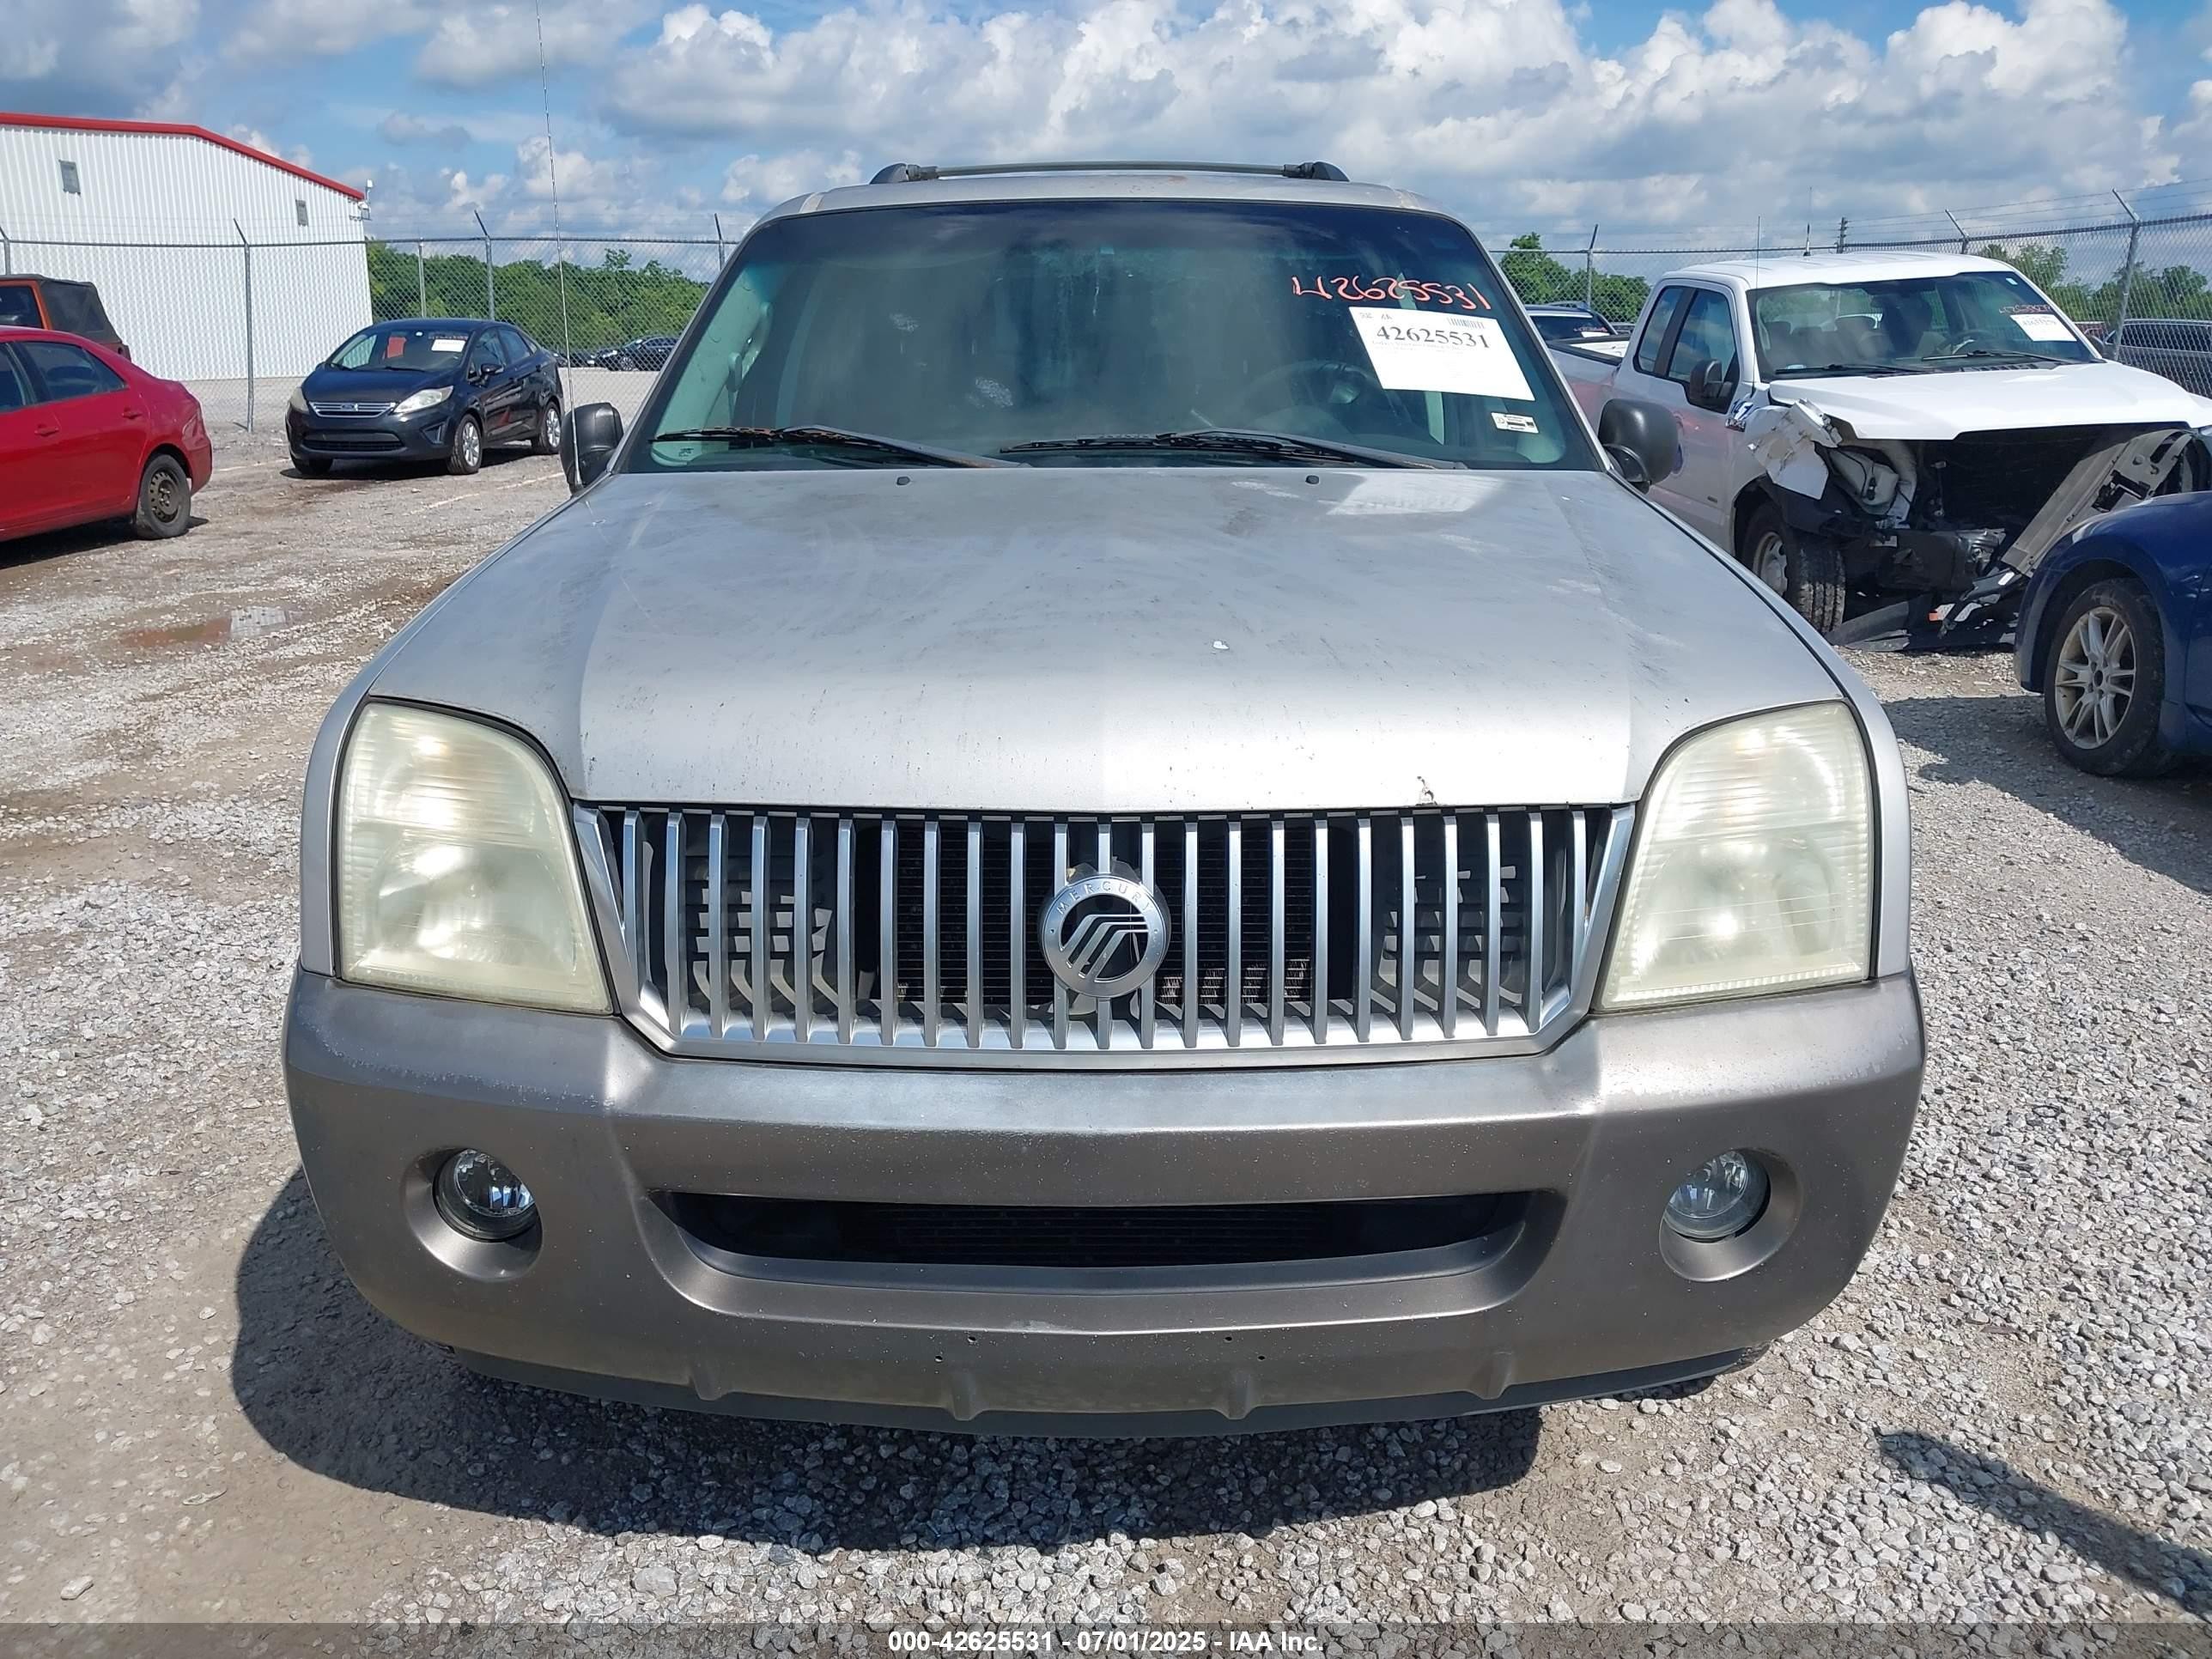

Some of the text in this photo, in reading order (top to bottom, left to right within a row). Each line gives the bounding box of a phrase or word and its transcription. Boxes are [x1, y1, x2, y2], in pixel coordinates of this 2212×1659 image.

[1291, 275, 1492, 310] 42625531
[1376, 325, 1490, 349] 42625531
[1056, 880, 1153, 915] MERCURY
